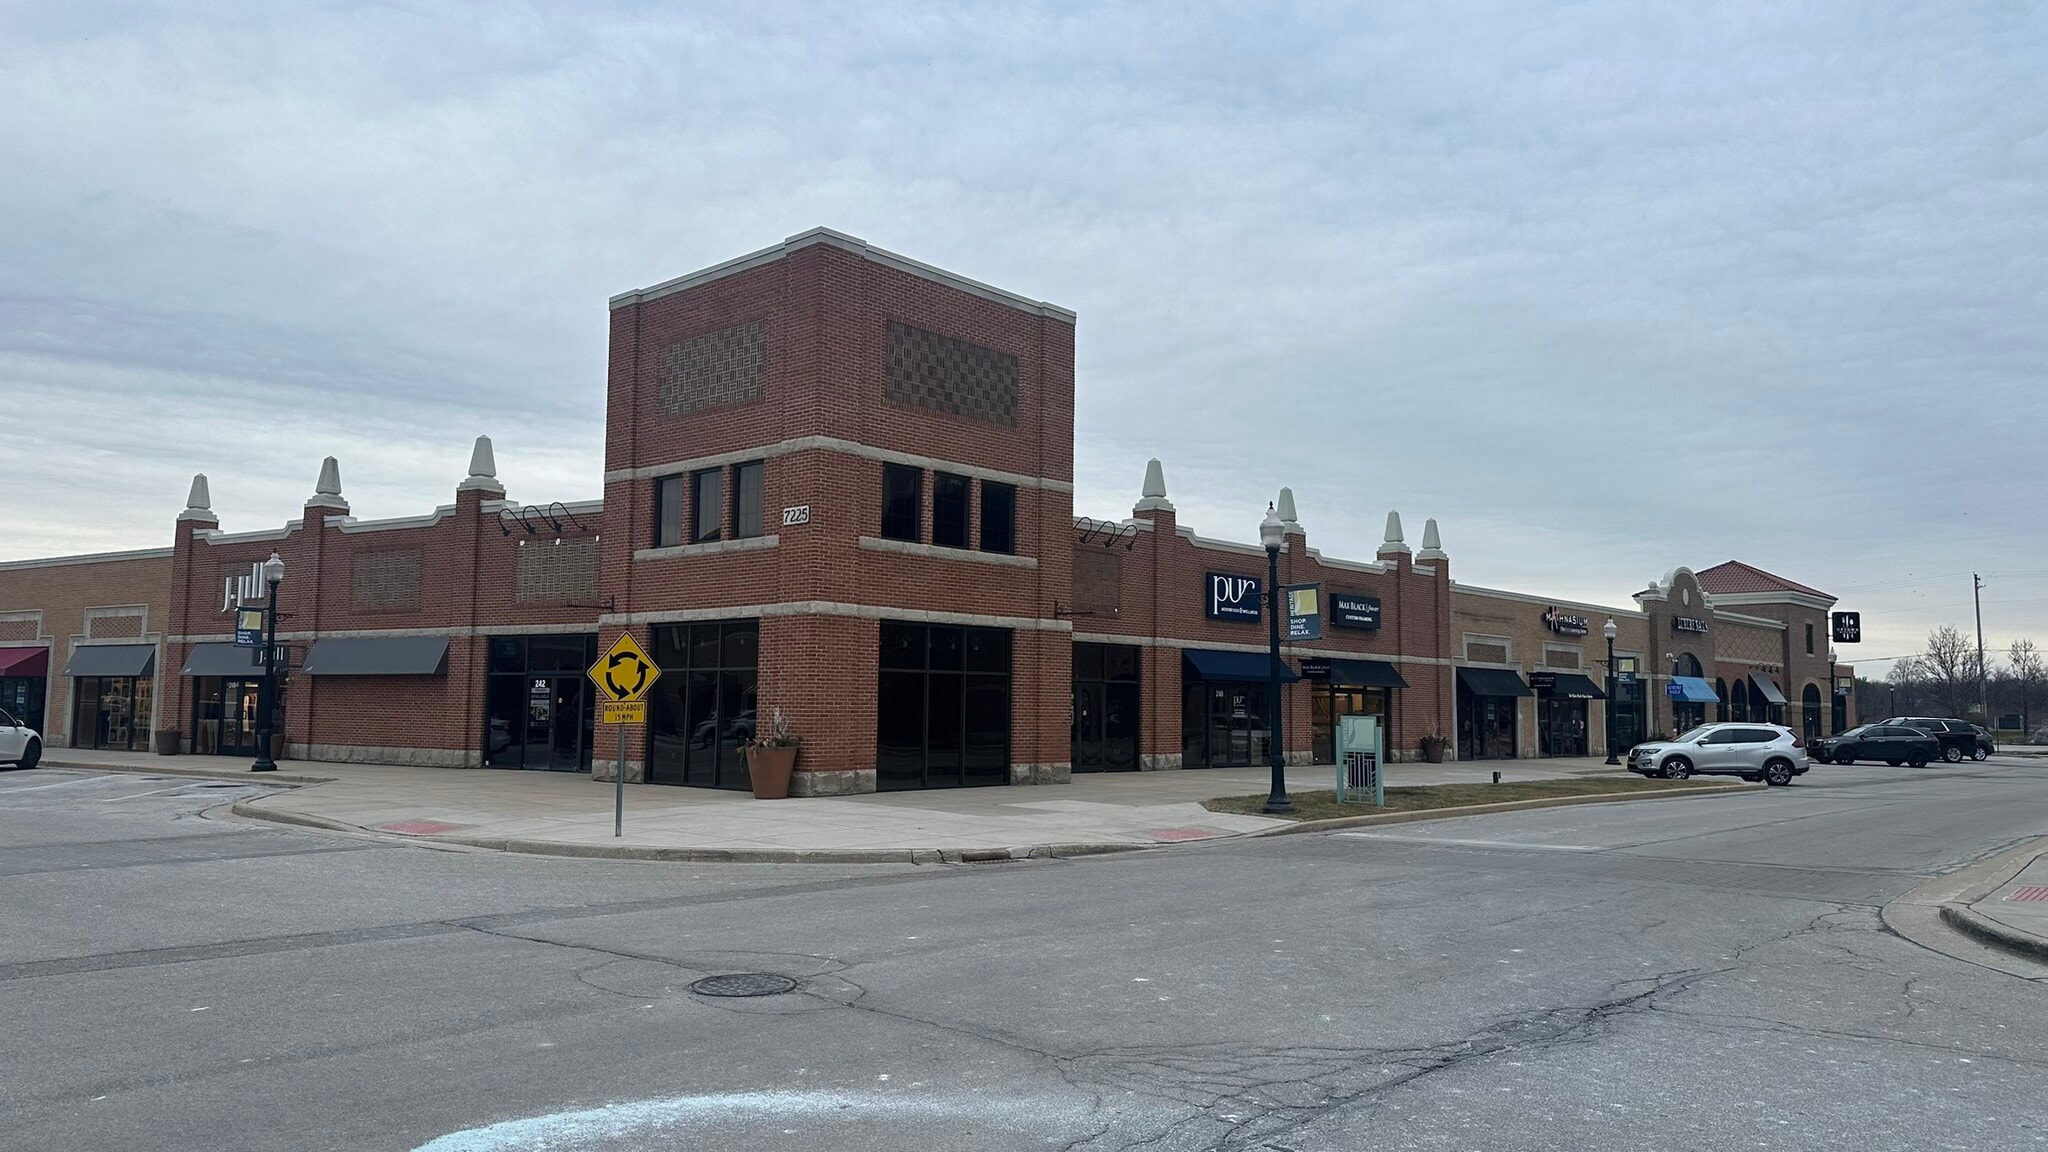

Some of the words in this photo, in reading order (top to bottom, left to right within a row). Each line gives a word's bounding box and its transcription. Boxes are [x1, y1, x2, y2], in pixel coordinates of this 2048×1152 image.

[784, 508, 808, 523] 7225
[1213, 575, 1256, 615] pur
[1350, 601, 1366, 611] BLACK
[1545, 607, 1588, 629] MATHNASIUM
[535, 679, 546, 688] 242
[604, 703, 644, 712] ROUND-ABOUT
